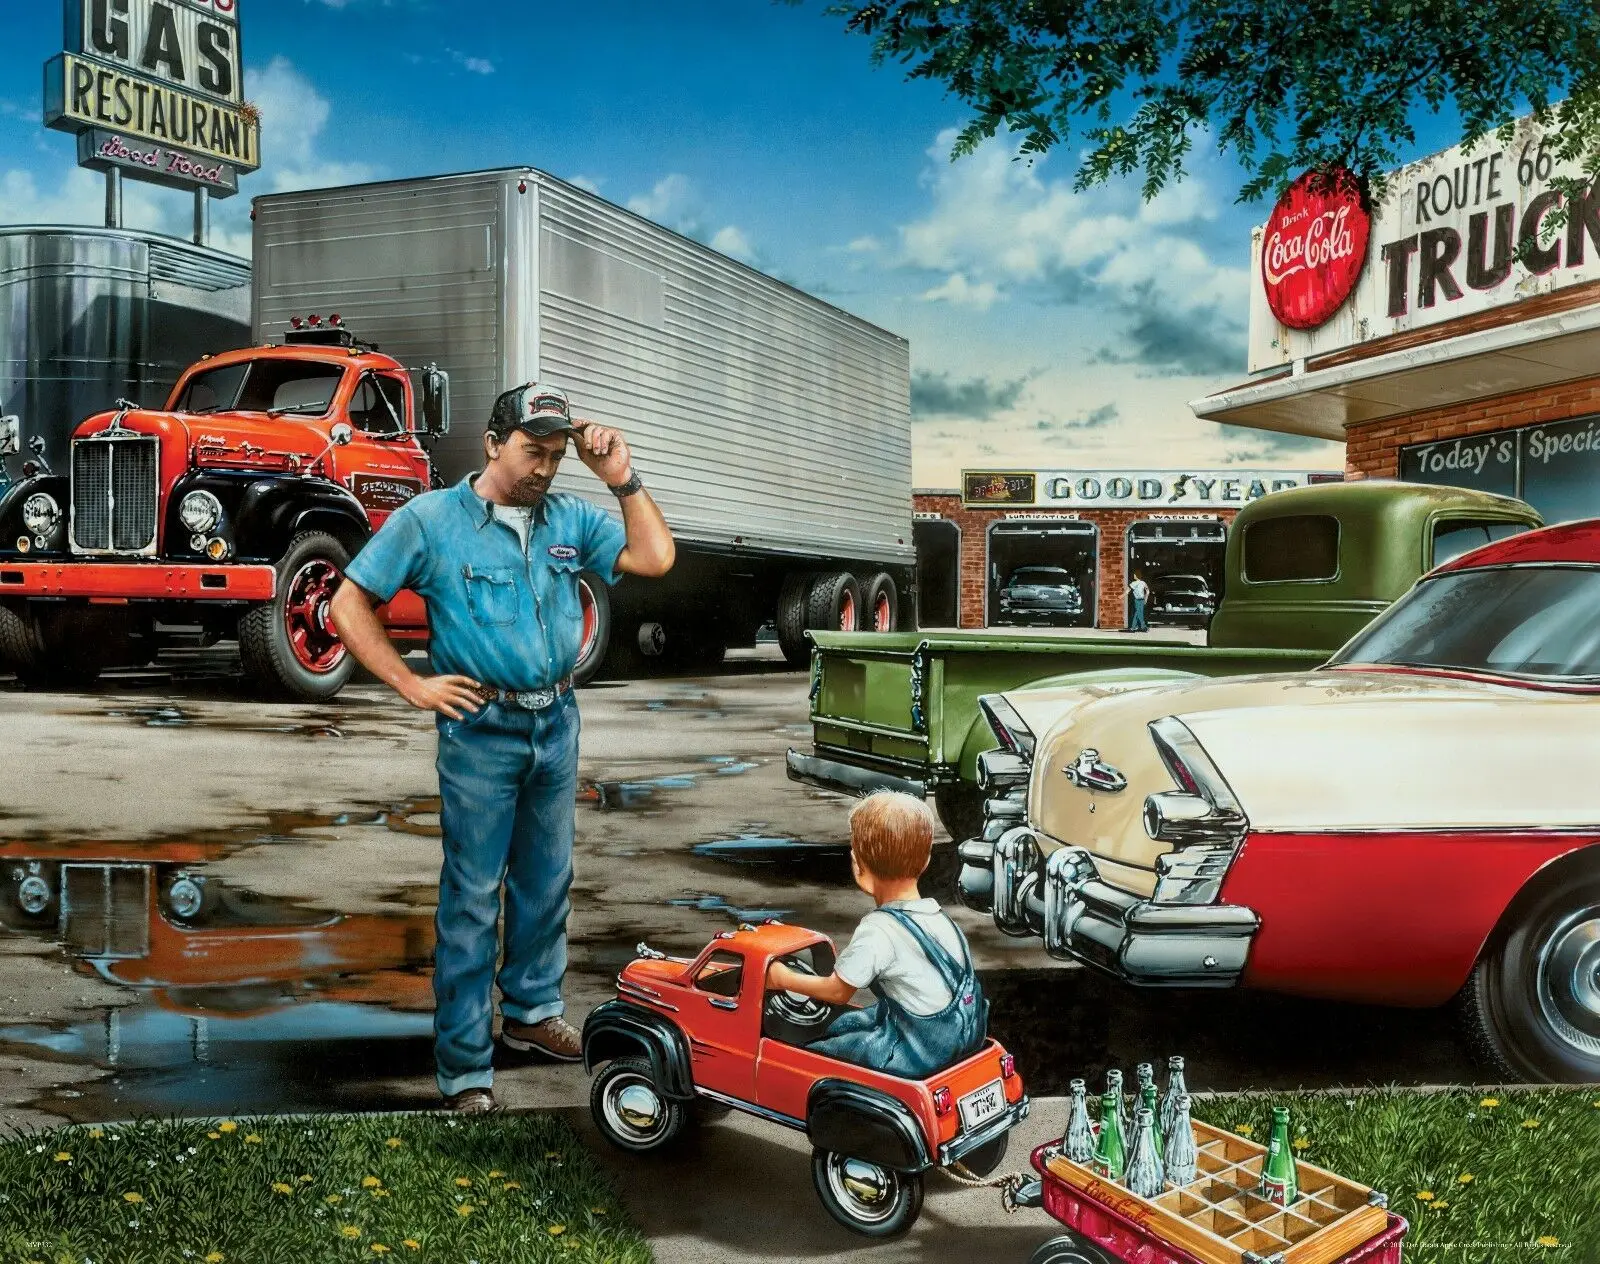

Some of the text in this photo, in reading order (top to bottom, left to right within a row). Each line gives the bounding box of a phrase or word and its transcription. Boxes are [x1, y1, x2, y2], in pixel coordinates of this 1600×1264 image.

[91, 0, 232, 96] GAS
[72, 61, 250, 161] RESTAURANT
[101, 135, 233, 187] Good Food
[1416, 133, 1552, 224] ROUTE 66
[1282, 207, 1309, 230] Drink
[1381, 172, 1600, 319] TRUCK
[1044, 477, 1163, 501] GOOD
[1416, 437, 1513, 475] Today's
